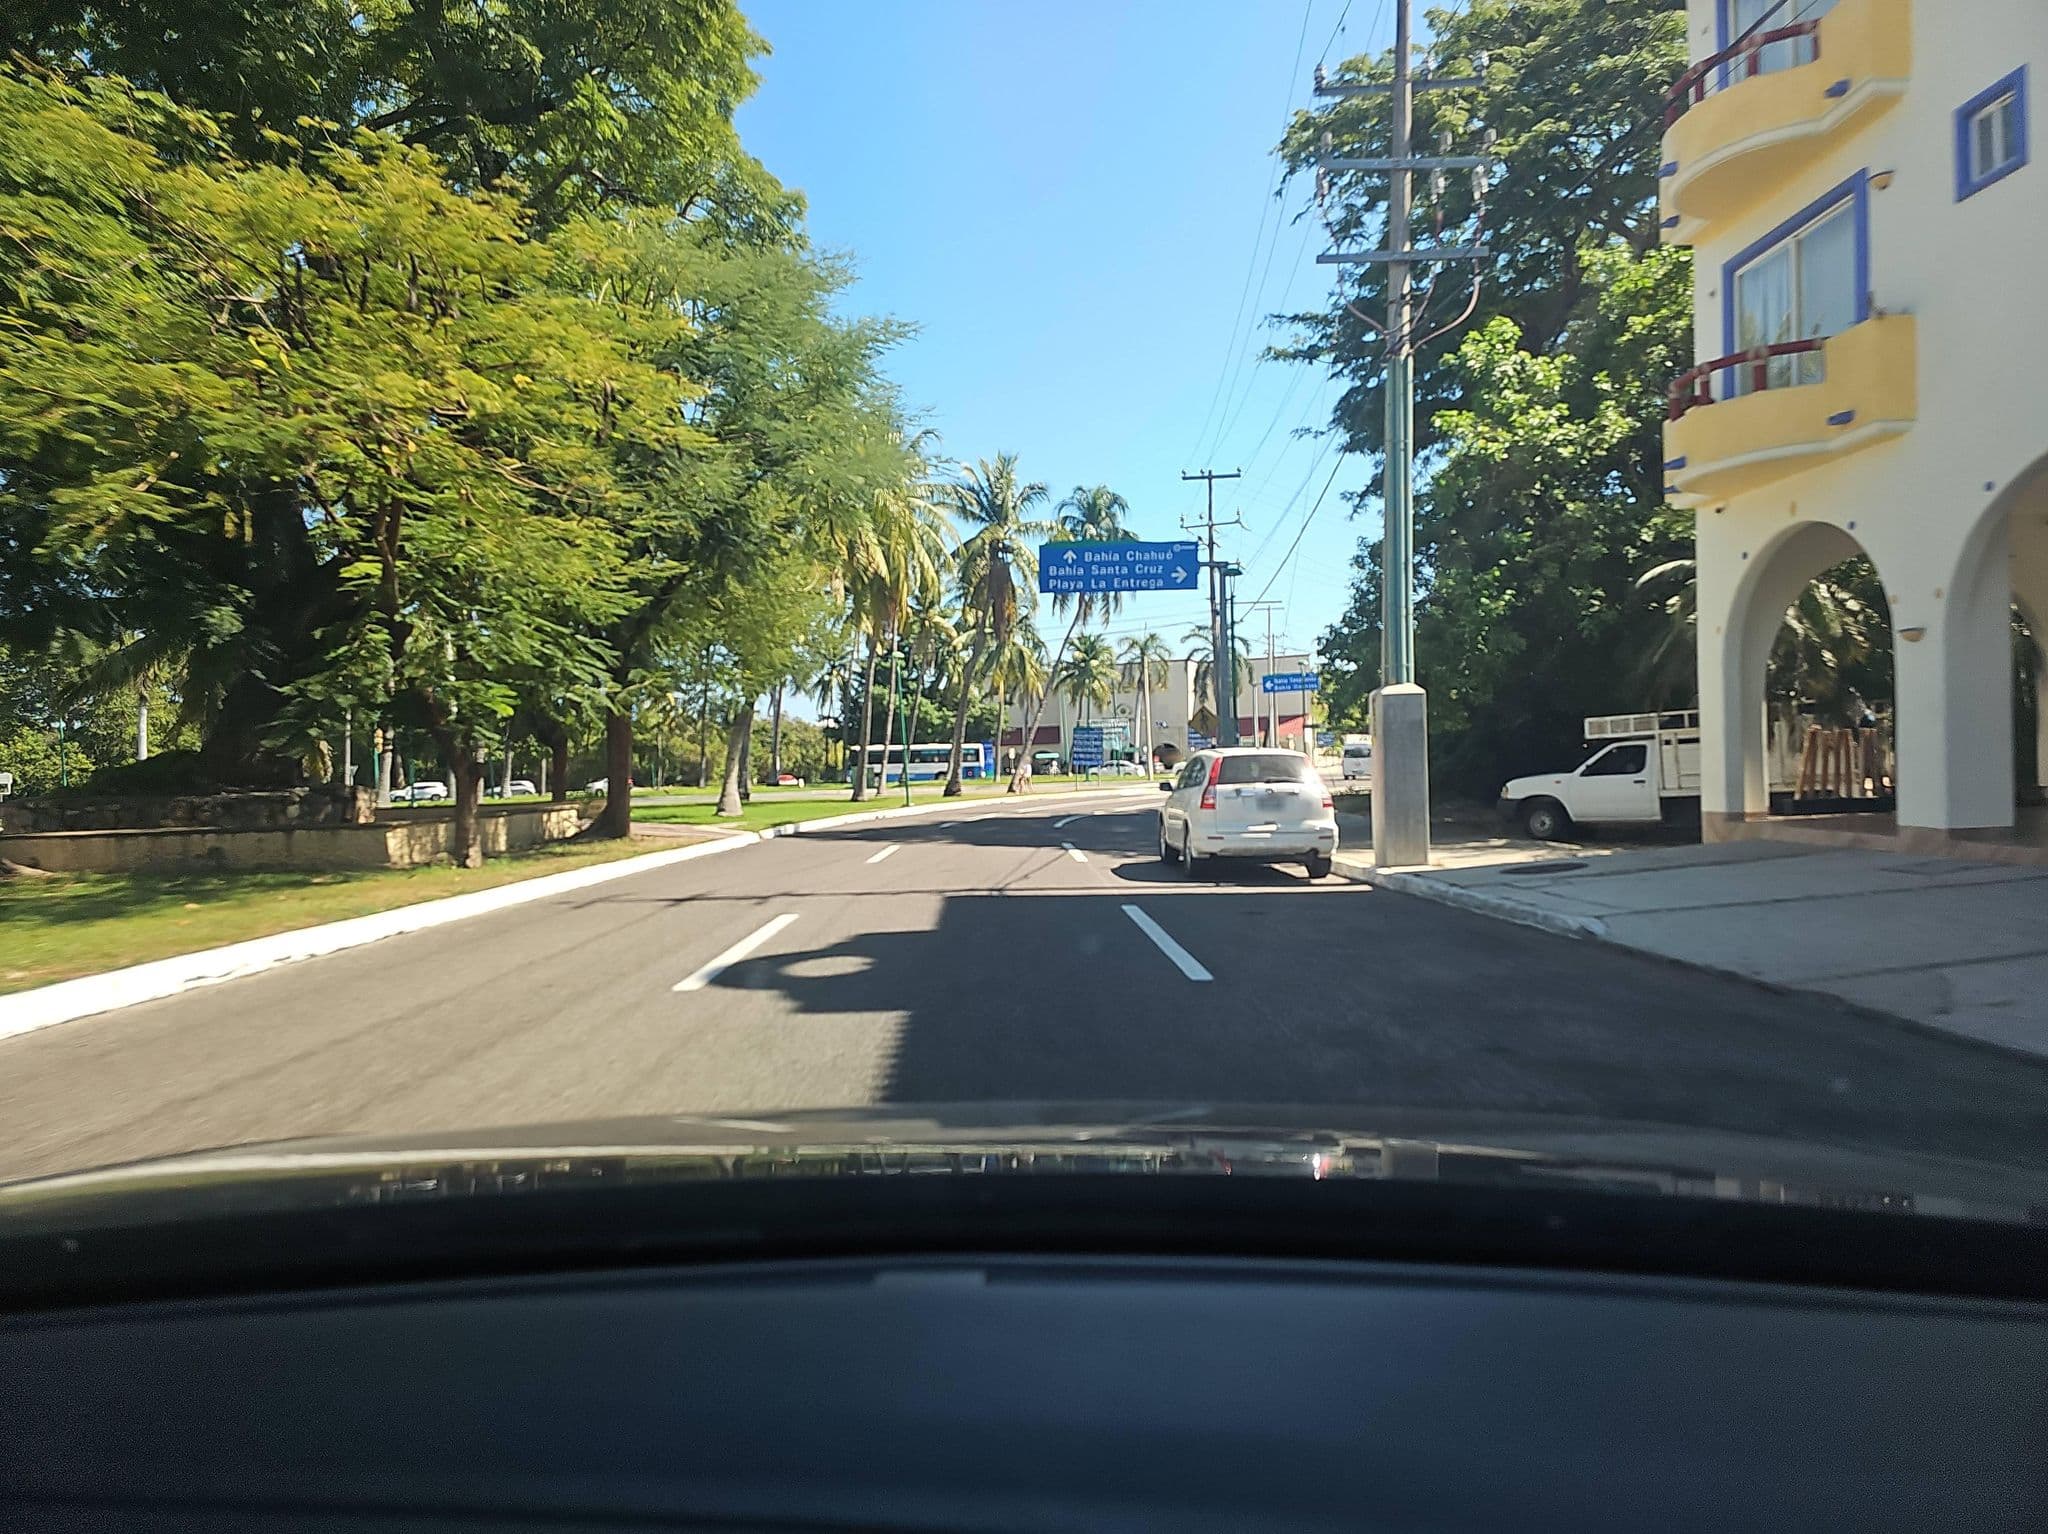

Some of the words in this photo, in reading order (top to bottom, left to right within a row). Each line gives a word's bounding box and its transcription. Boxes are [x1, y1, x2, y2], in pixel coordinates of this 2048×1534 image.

[1091, 564, 1128, 576] Santa
[1135, 563, 1164, 574] Cruz
[1048, 578, 1083, 590] Playa
[1091, 578, 1106, 589] La
[1114, 577, 1163, 589] Entrega
